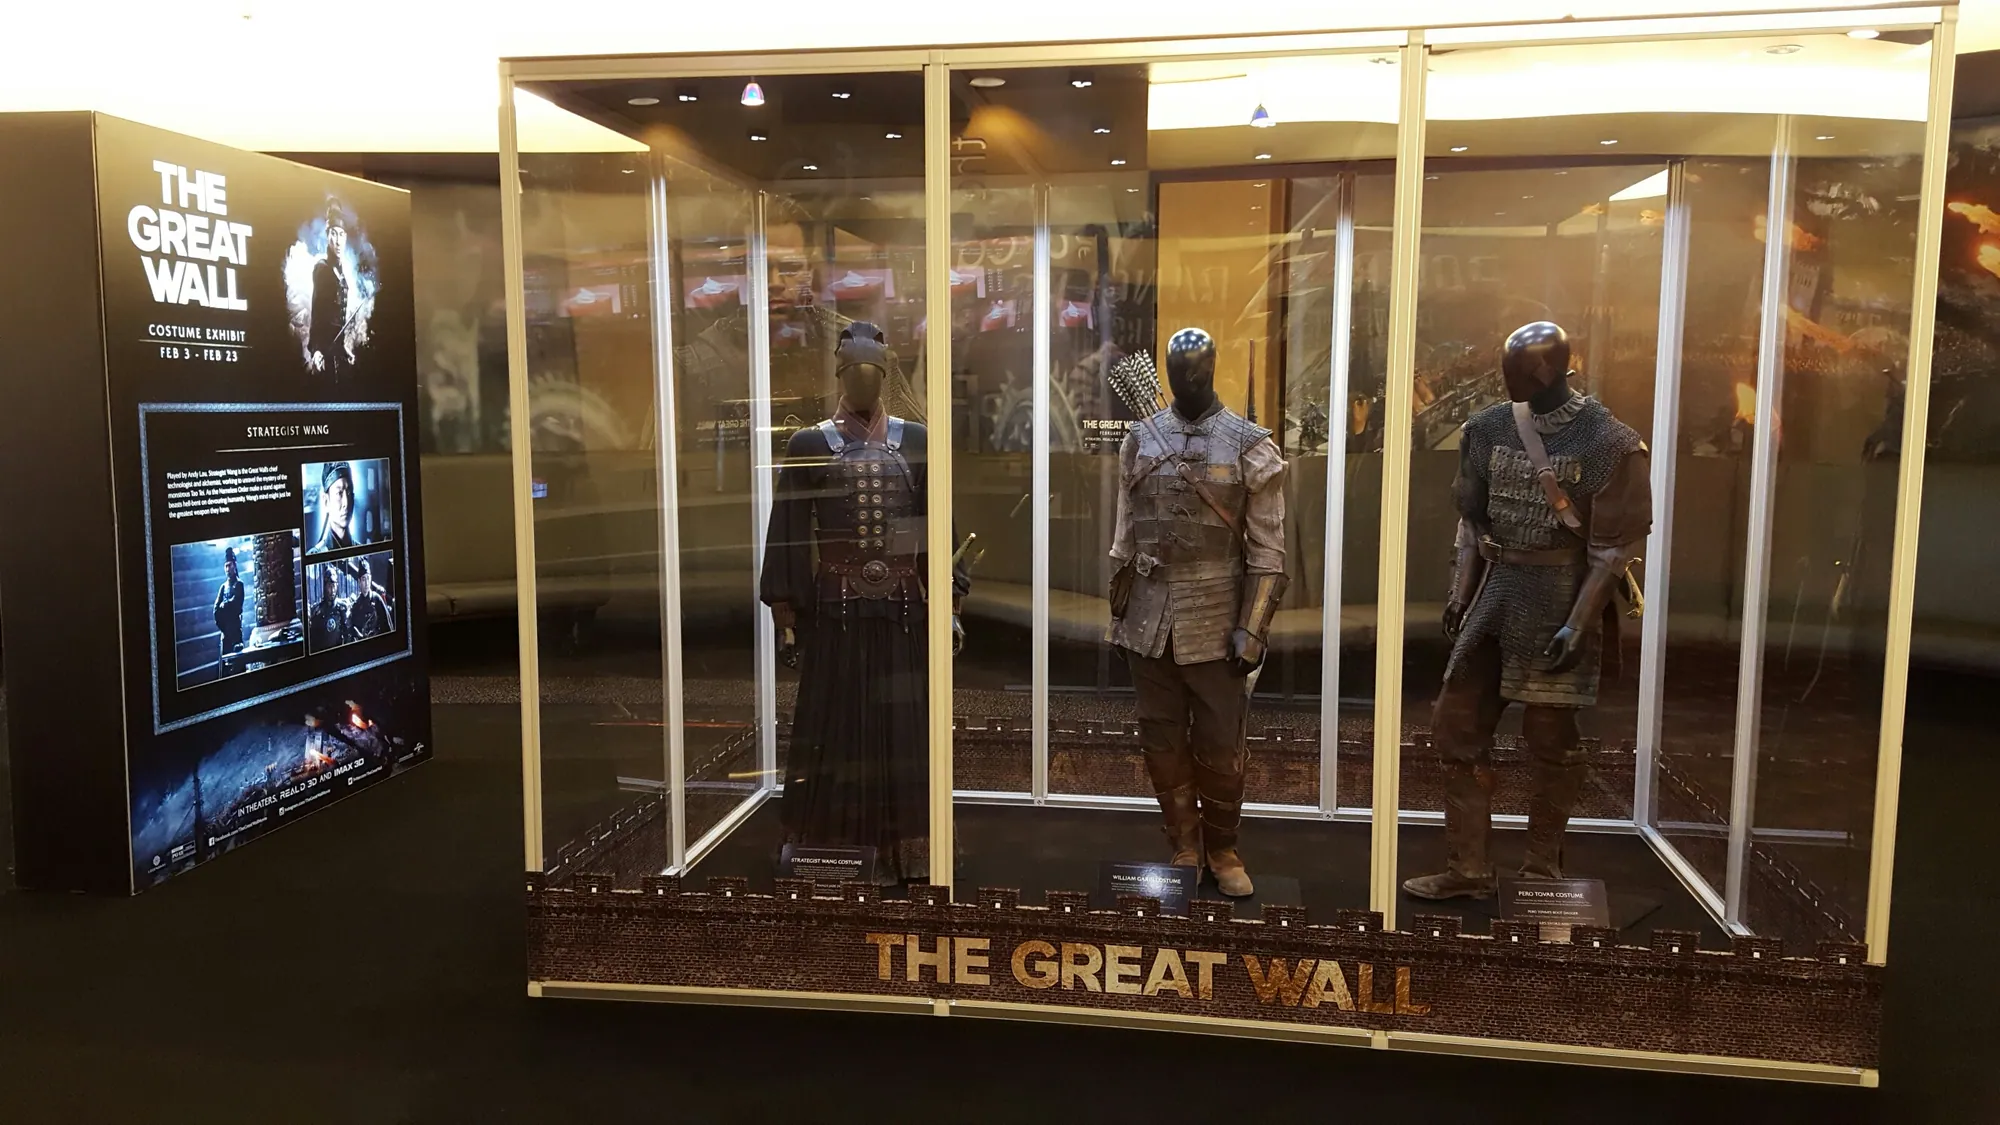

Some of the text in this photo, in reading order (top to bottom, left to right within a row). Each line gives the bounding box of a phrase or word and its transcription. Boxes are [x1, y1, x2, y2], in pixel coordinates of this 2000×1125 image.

[153, 160, 228, 216] THE
[127, 205, 253, 266] GREAT
[141, 255, 248, 311] WALL
[148, 324, 246, 342] COSTUME EXHIBIT
[160, 347, 179, 360] FEB
[184, 348, 191, 360] 3
[203, 349, 222, 362] FEB
[226, 351, 239, 363] 23
[247, 425, 330, 437] STRATEGIST WANG
[1082, 420, 1098, 429] THE
[1098, 420, 1123, 430] GREAT
[166, 472, 182, 480] Played
[188, 471, 199, 479] Andy
[208, 469, 226, 477] Strategist
[168, 501, 183, 509] beasts
[268, 492, 279, 500] might
[177, 510, 194, 519] greatest
[237, 809, 245, 818] IN
[307, 778, 318, 789] 3D
[319, 771, 333, 783] AND
[333, 761, 354, 777] IMAX
[354, 757, 365, 768] 3D
[865, 933, 1432, 1017] THE GREAT WALL
